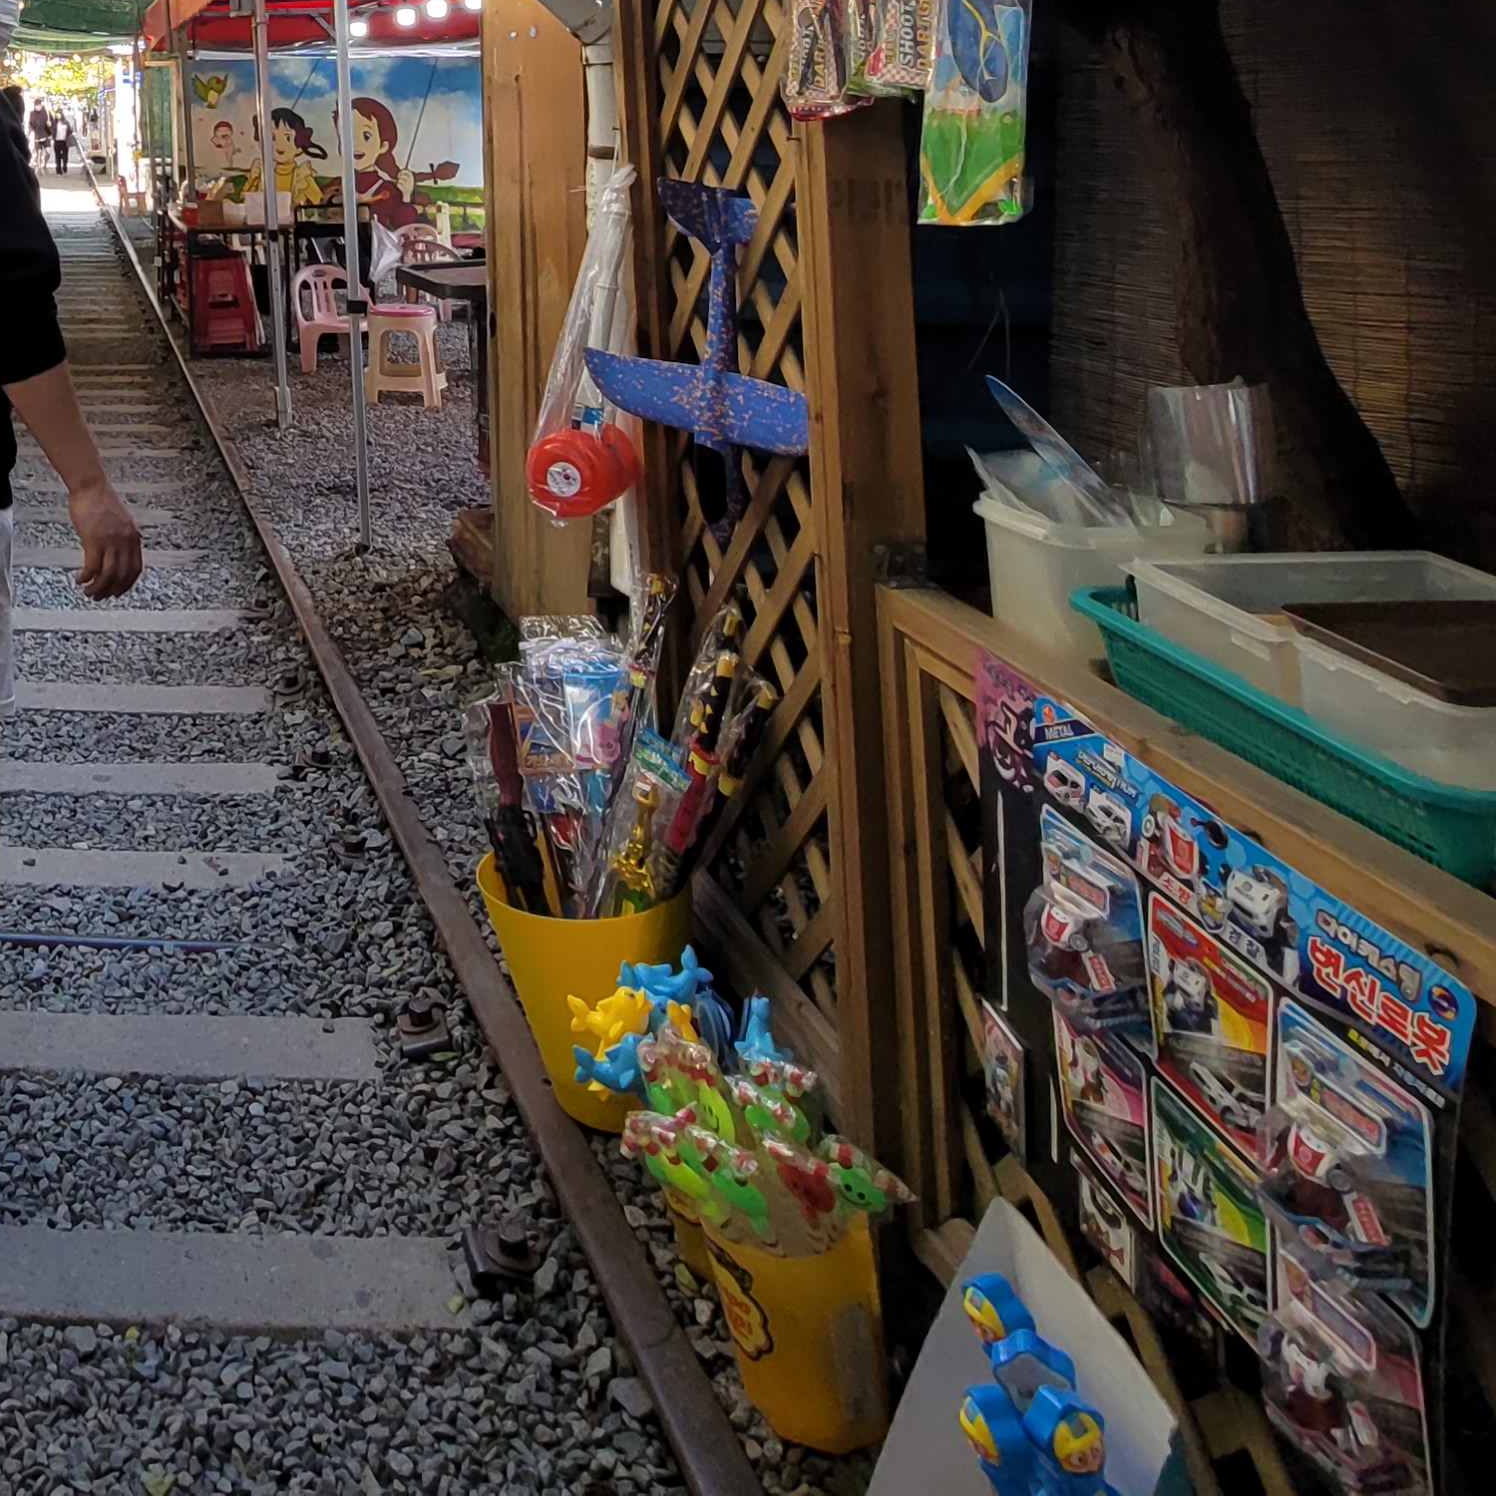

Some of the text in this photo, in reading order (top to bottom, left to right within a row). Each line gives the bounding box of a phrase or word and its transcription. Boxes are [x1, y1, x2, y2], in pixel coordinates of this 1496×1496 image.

[898, 0, 915, 70] SHOOT
[1044, 723, 1075, 740] METAL
[1308, 936, 1452, 1076] 변신로봇
